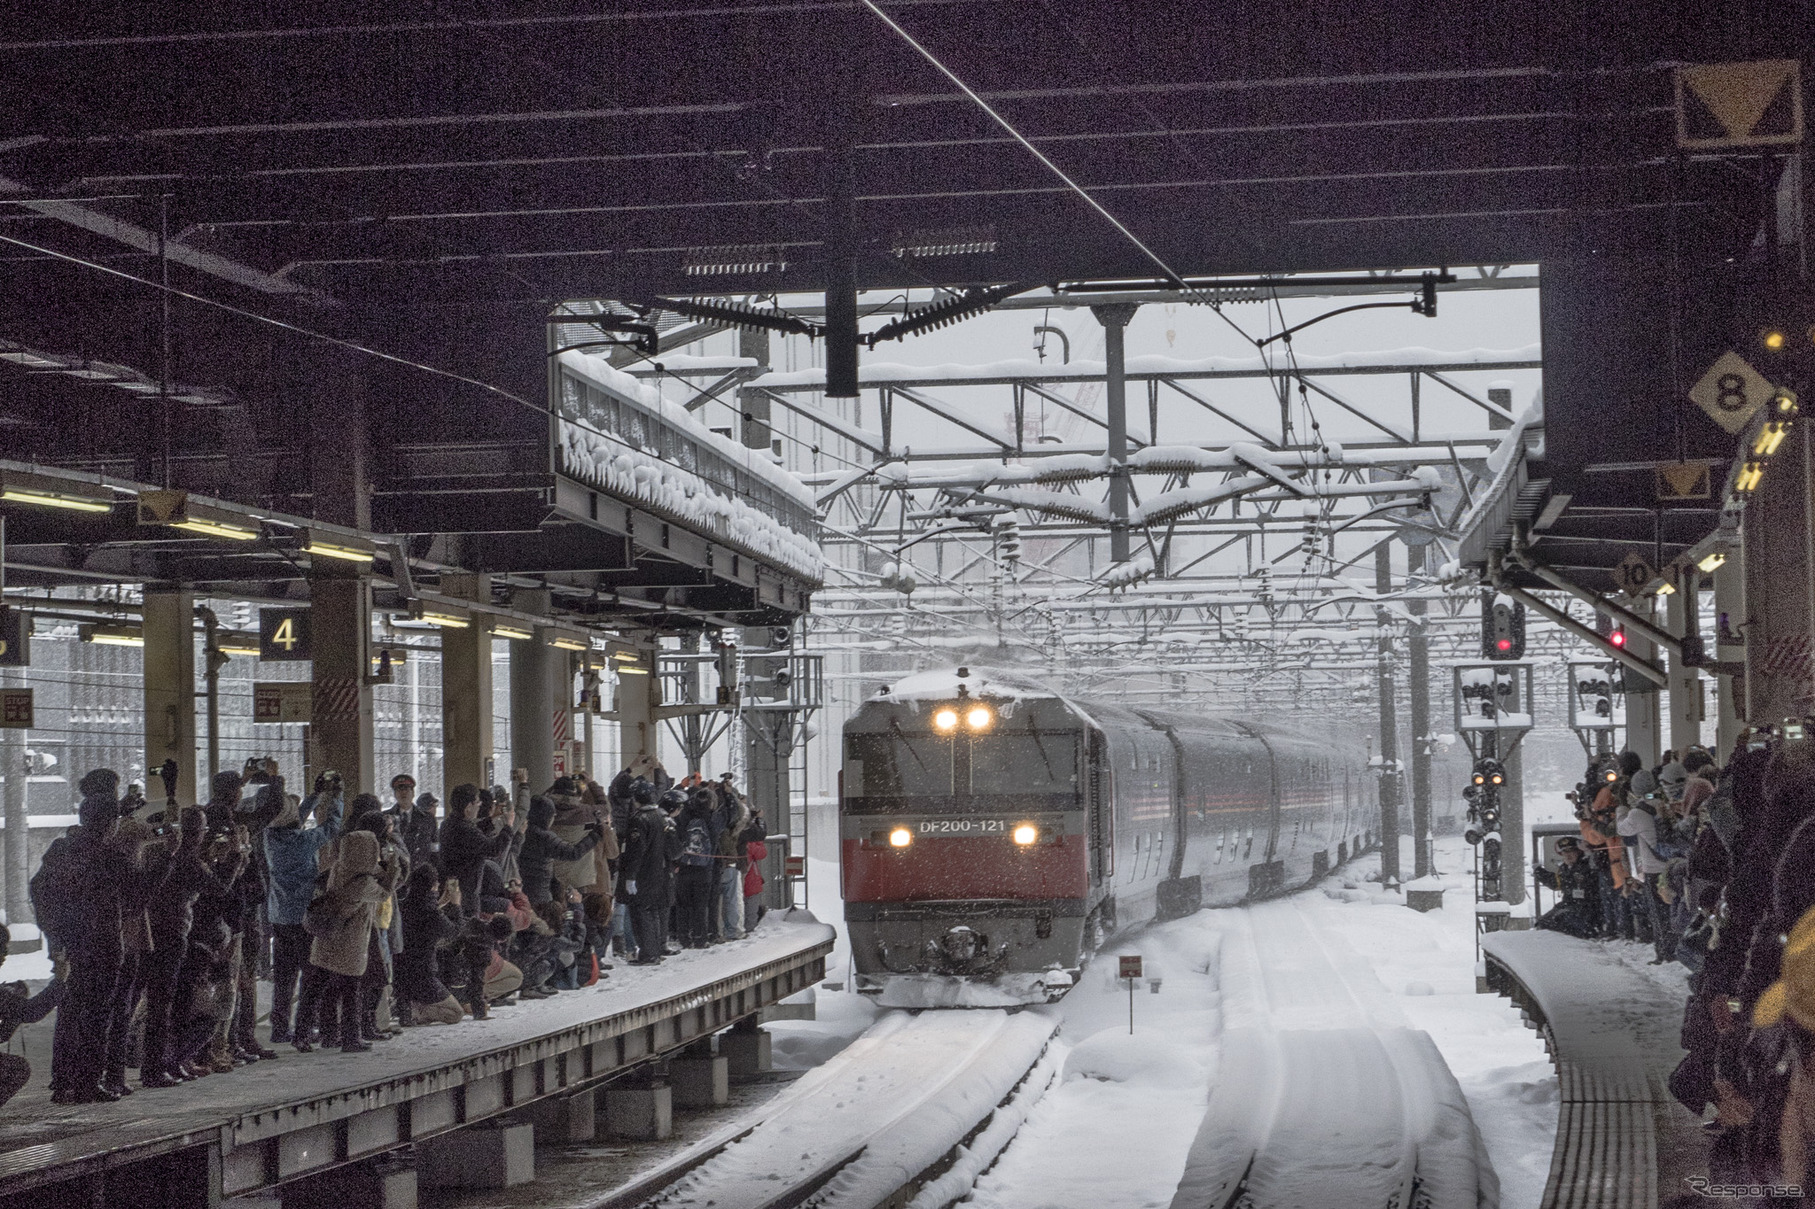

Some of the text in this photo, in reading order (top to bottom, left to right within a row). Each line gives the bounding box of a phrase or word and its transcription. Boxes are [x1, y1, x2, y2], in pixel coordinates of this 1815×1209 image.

[1716, 373, 1747, 413] 8
[1623, 563, 1647, 585] 10
[272, 618, 297, 651] 4
[920, 820, 1005, 833] DF200-121
